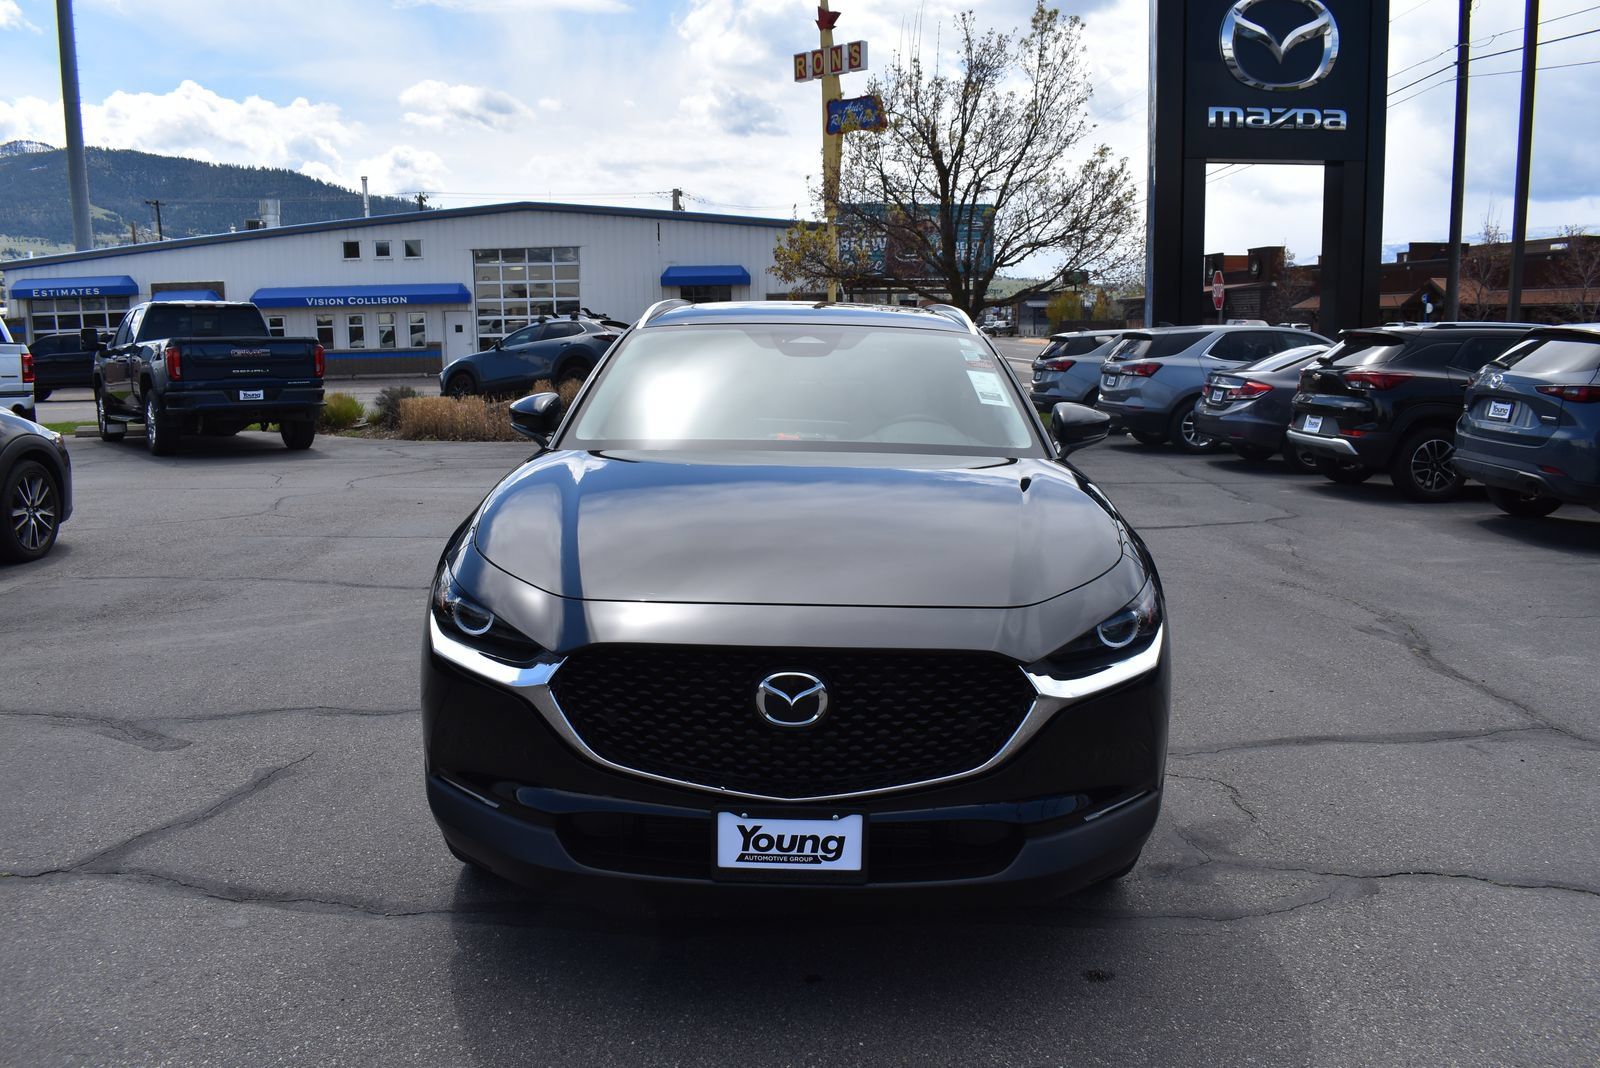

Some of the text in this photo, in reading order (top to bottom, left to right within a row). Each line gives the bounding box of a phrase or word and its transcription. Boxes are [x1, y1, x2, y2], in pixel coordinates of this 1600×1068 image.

[796, 45, 860, 78] RONS
[1208, 106, 1347, 131] mazda
[32, 287, 101, 297] ESTIMATES
[306, 296, 408, 306] VISION COLLISION
[736, 824, 846, 863] Young
[744, 854, 814, 863] AUTOMOTIVE GROUP
